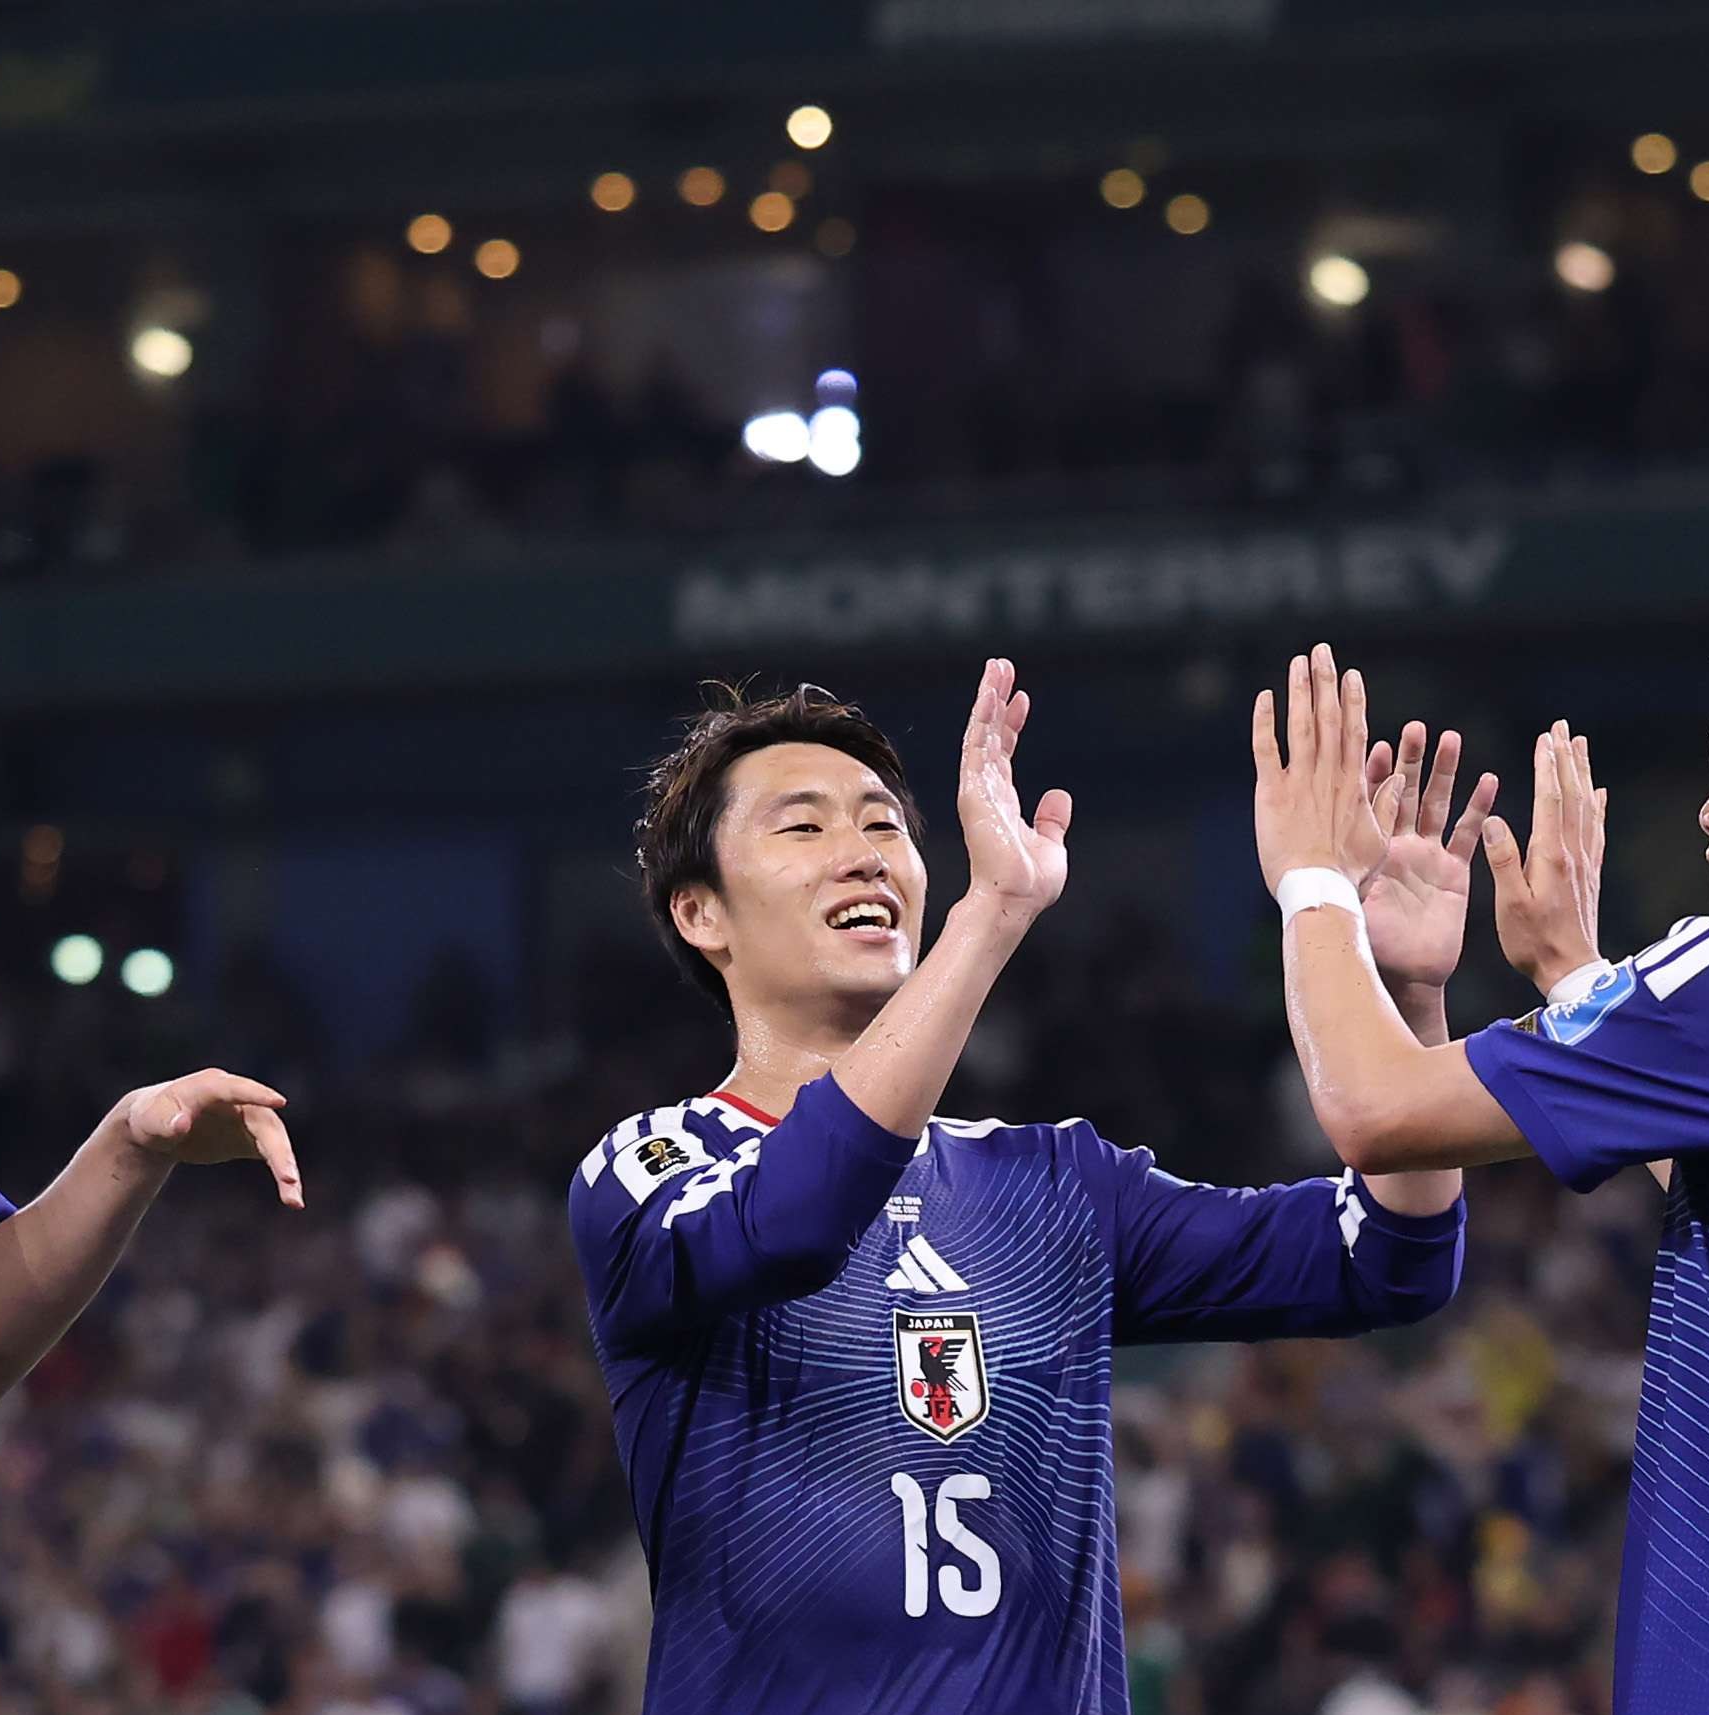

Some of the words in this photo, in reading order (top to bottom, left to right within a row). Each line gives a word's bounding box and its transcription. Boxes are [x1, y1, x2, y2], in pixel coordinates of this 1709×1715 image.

[677, 528, 1504, 640] MONTERREY
[907, 1318, 955, 1329] JAPAN
[922, 1400, 963, 1418] JFA
[890, 1472, 1002, 1618] 15
